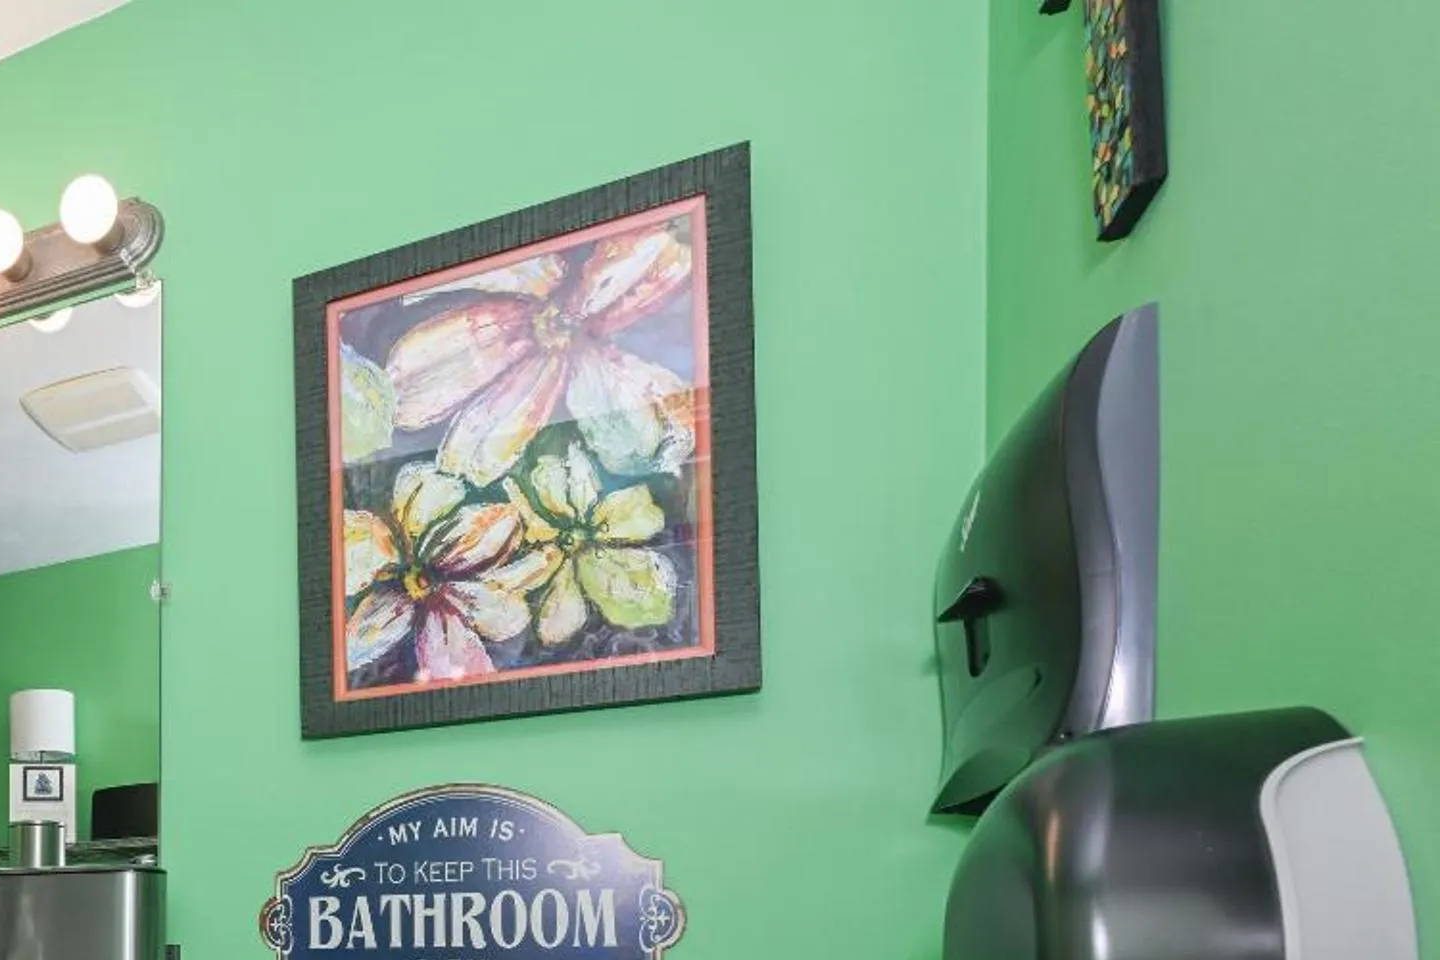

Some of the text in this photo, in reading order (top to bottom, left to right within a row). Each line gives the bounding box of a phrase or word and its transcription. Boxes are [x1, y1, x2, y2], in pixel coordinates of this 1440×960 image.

[388, 817, 515, 845] MY AIM IS
[374, 857, 537, 885] TO KEEP THIS
[308, 889, 619, 950] BATHROOM
